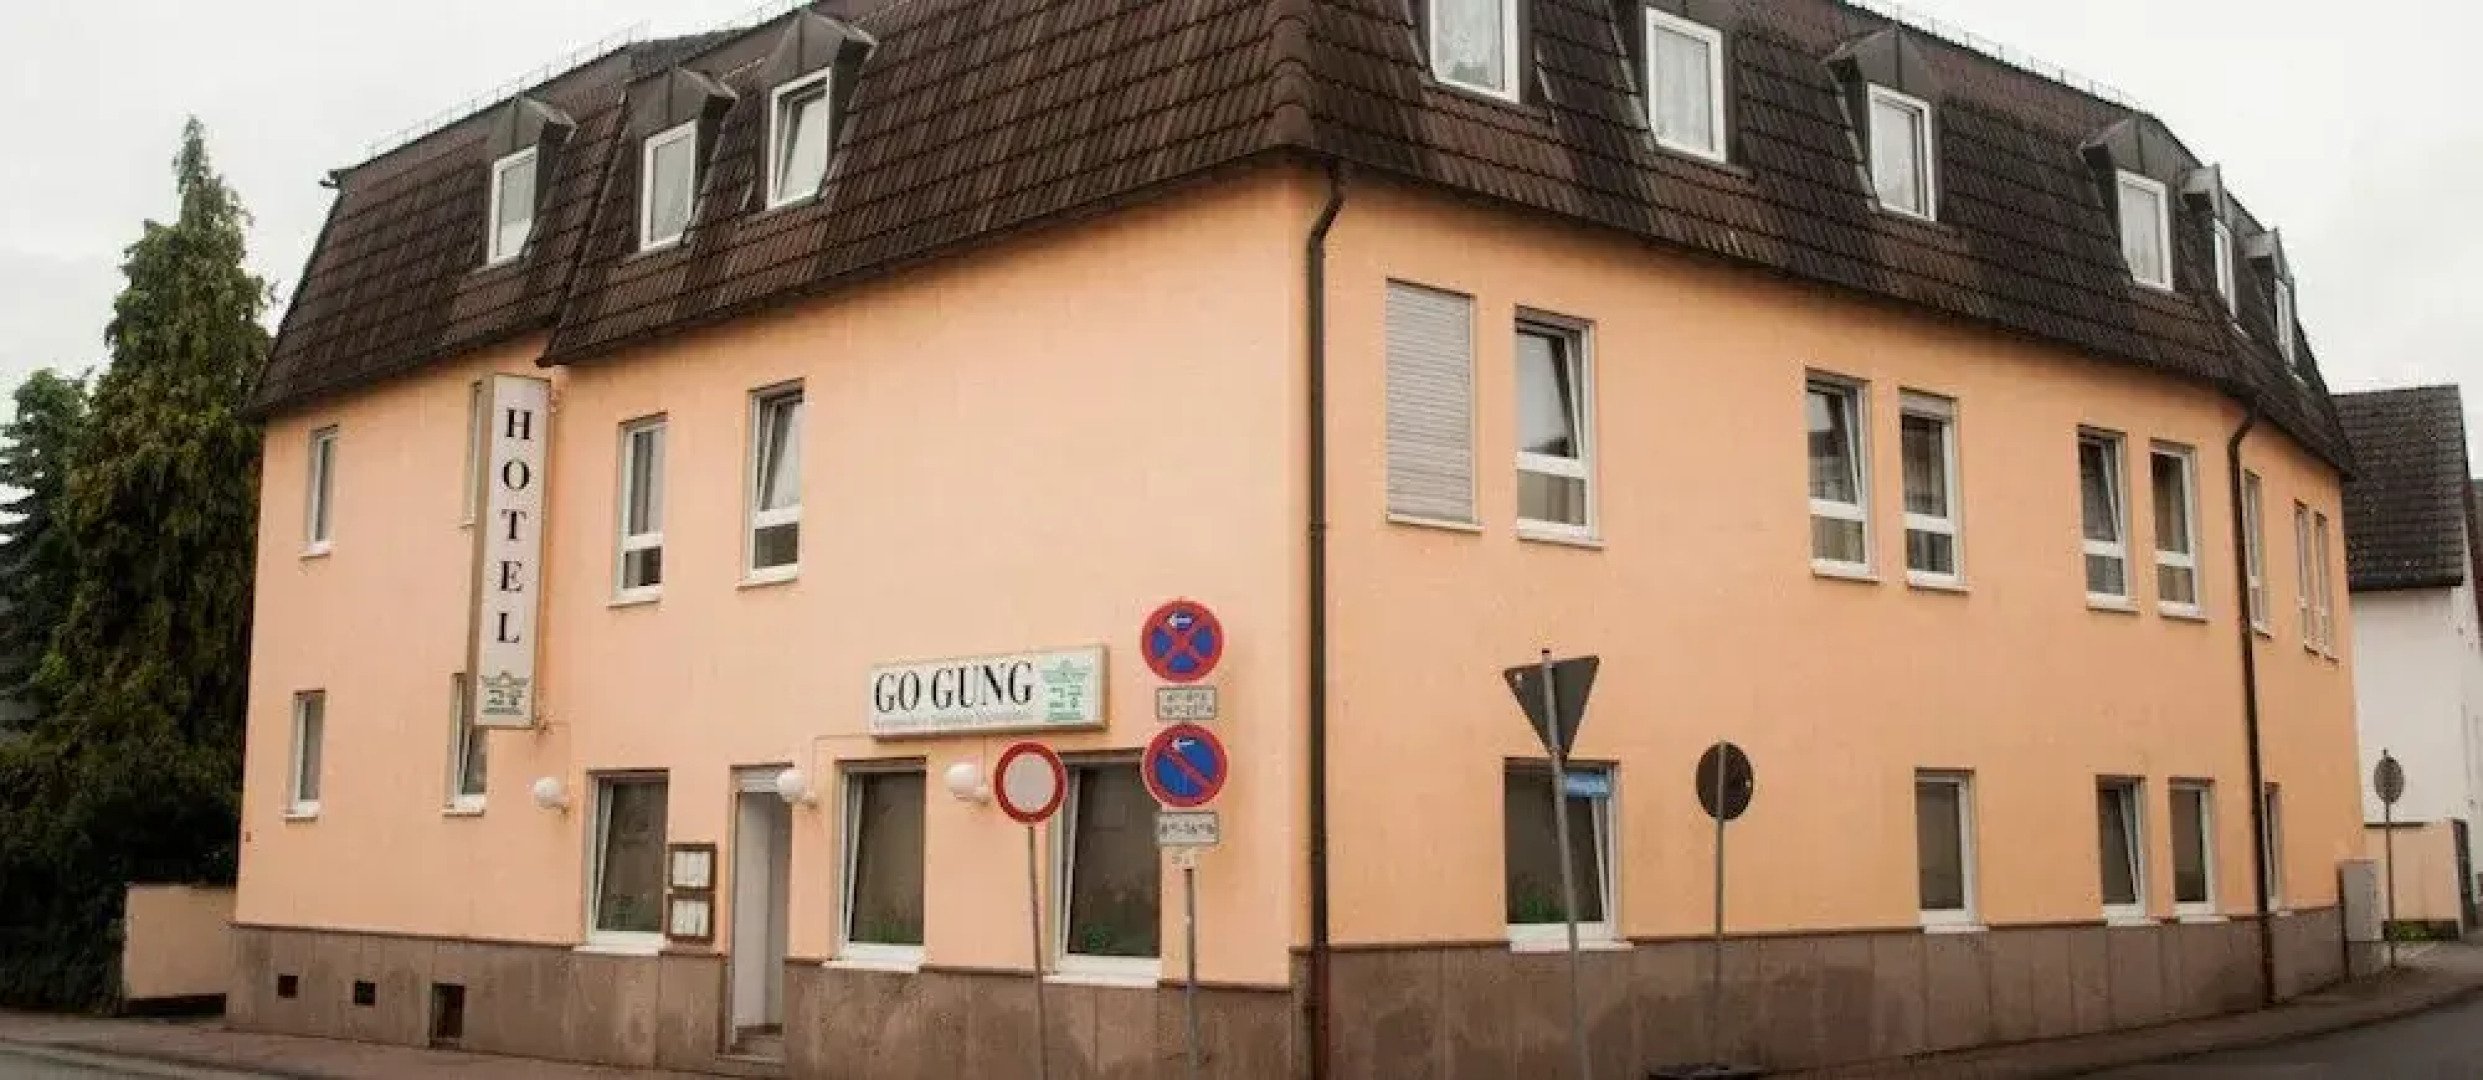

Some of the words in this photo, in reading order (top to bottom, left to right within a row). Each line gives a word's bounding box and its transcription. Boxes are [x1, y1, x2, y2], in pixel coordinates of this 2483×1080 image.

[497, 407, 533, 644] HOTEL
[875, 671, 921, 713] GO
[931, 660, 1032, 710] GUNG
